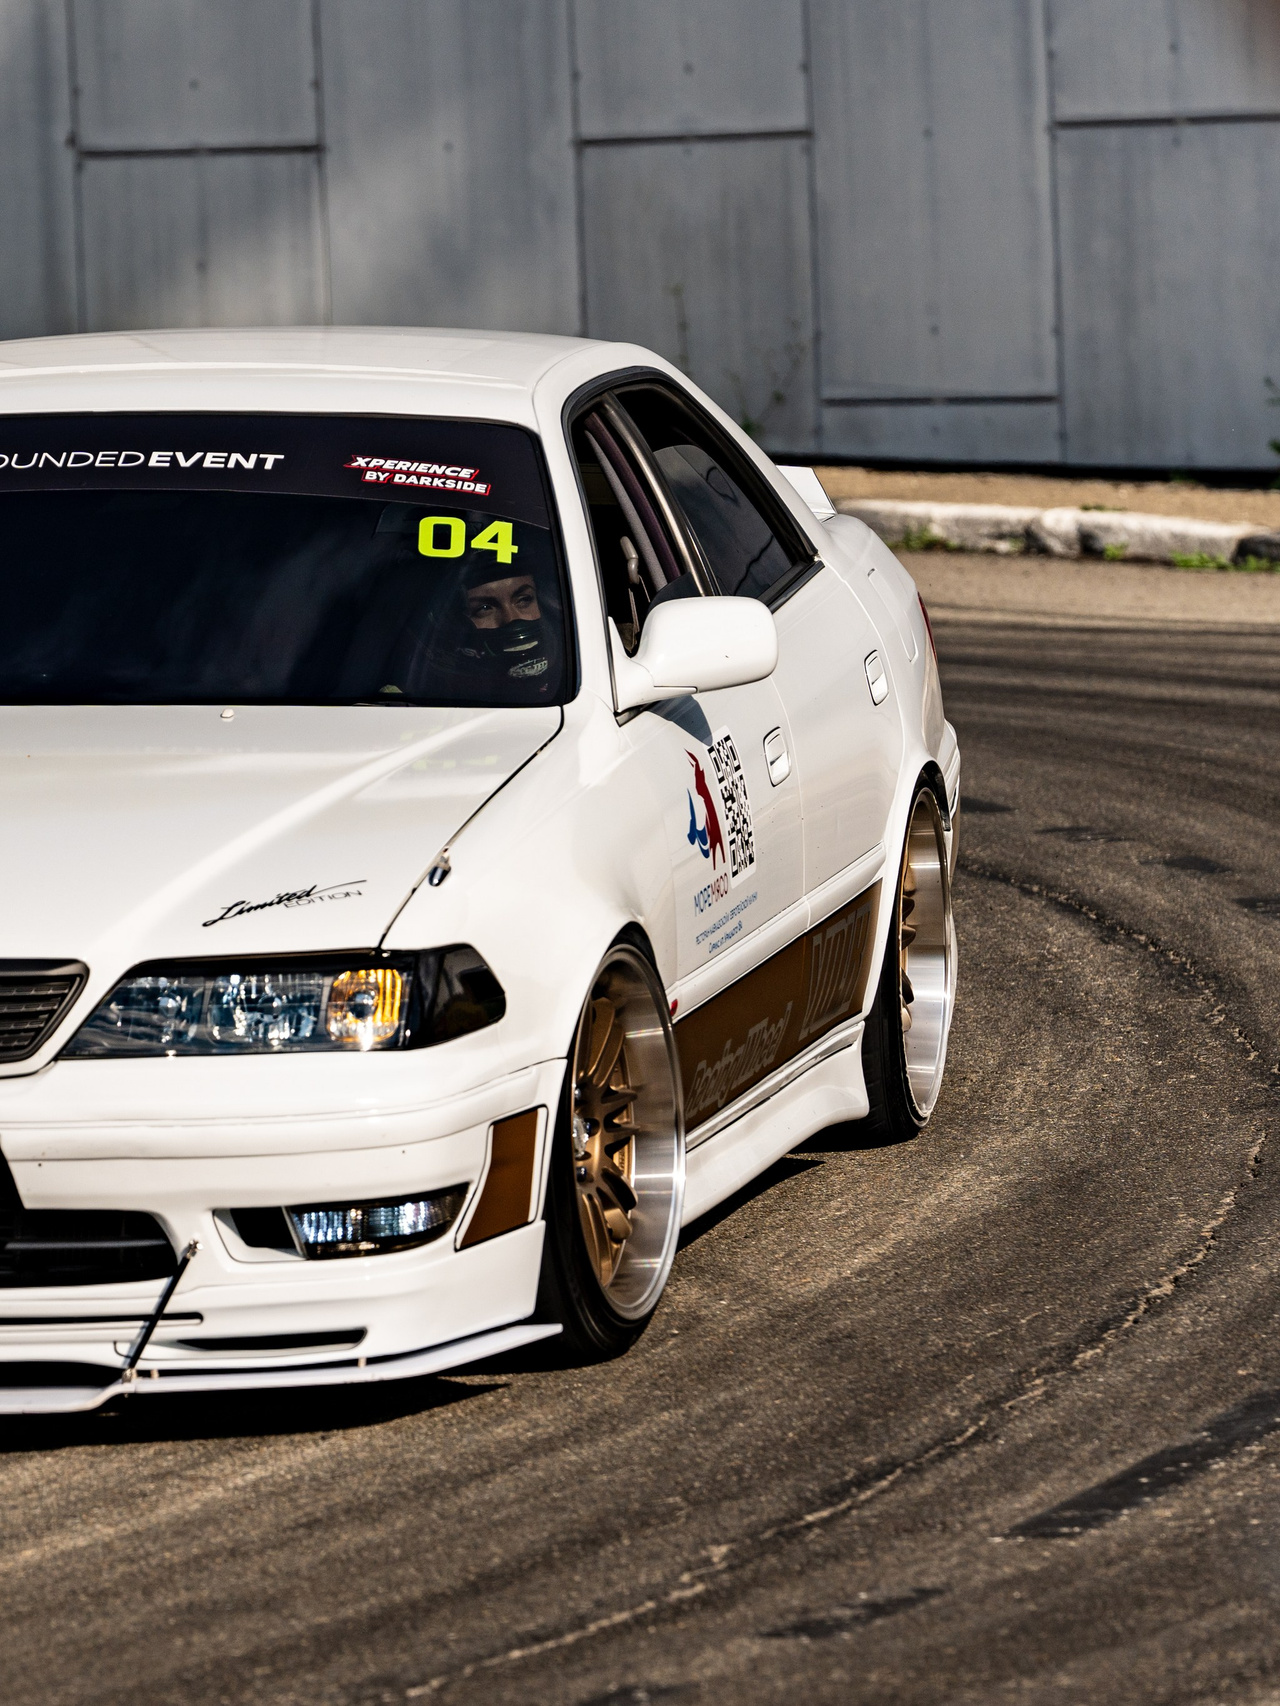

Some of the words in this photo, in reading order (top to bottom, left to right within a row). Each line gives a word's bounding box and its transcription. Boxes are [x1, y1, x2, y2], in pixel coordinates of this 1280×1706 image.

[350, 456, 475, 479] XPERIENCE
[364, 471, 390, 482] BY
[393, 473, 488, 494] DARKSIDE
[417, 516, 519, 564] 04
[202, 880, 367, 927] Limited
[283, 889, 363, 909] EDITION
